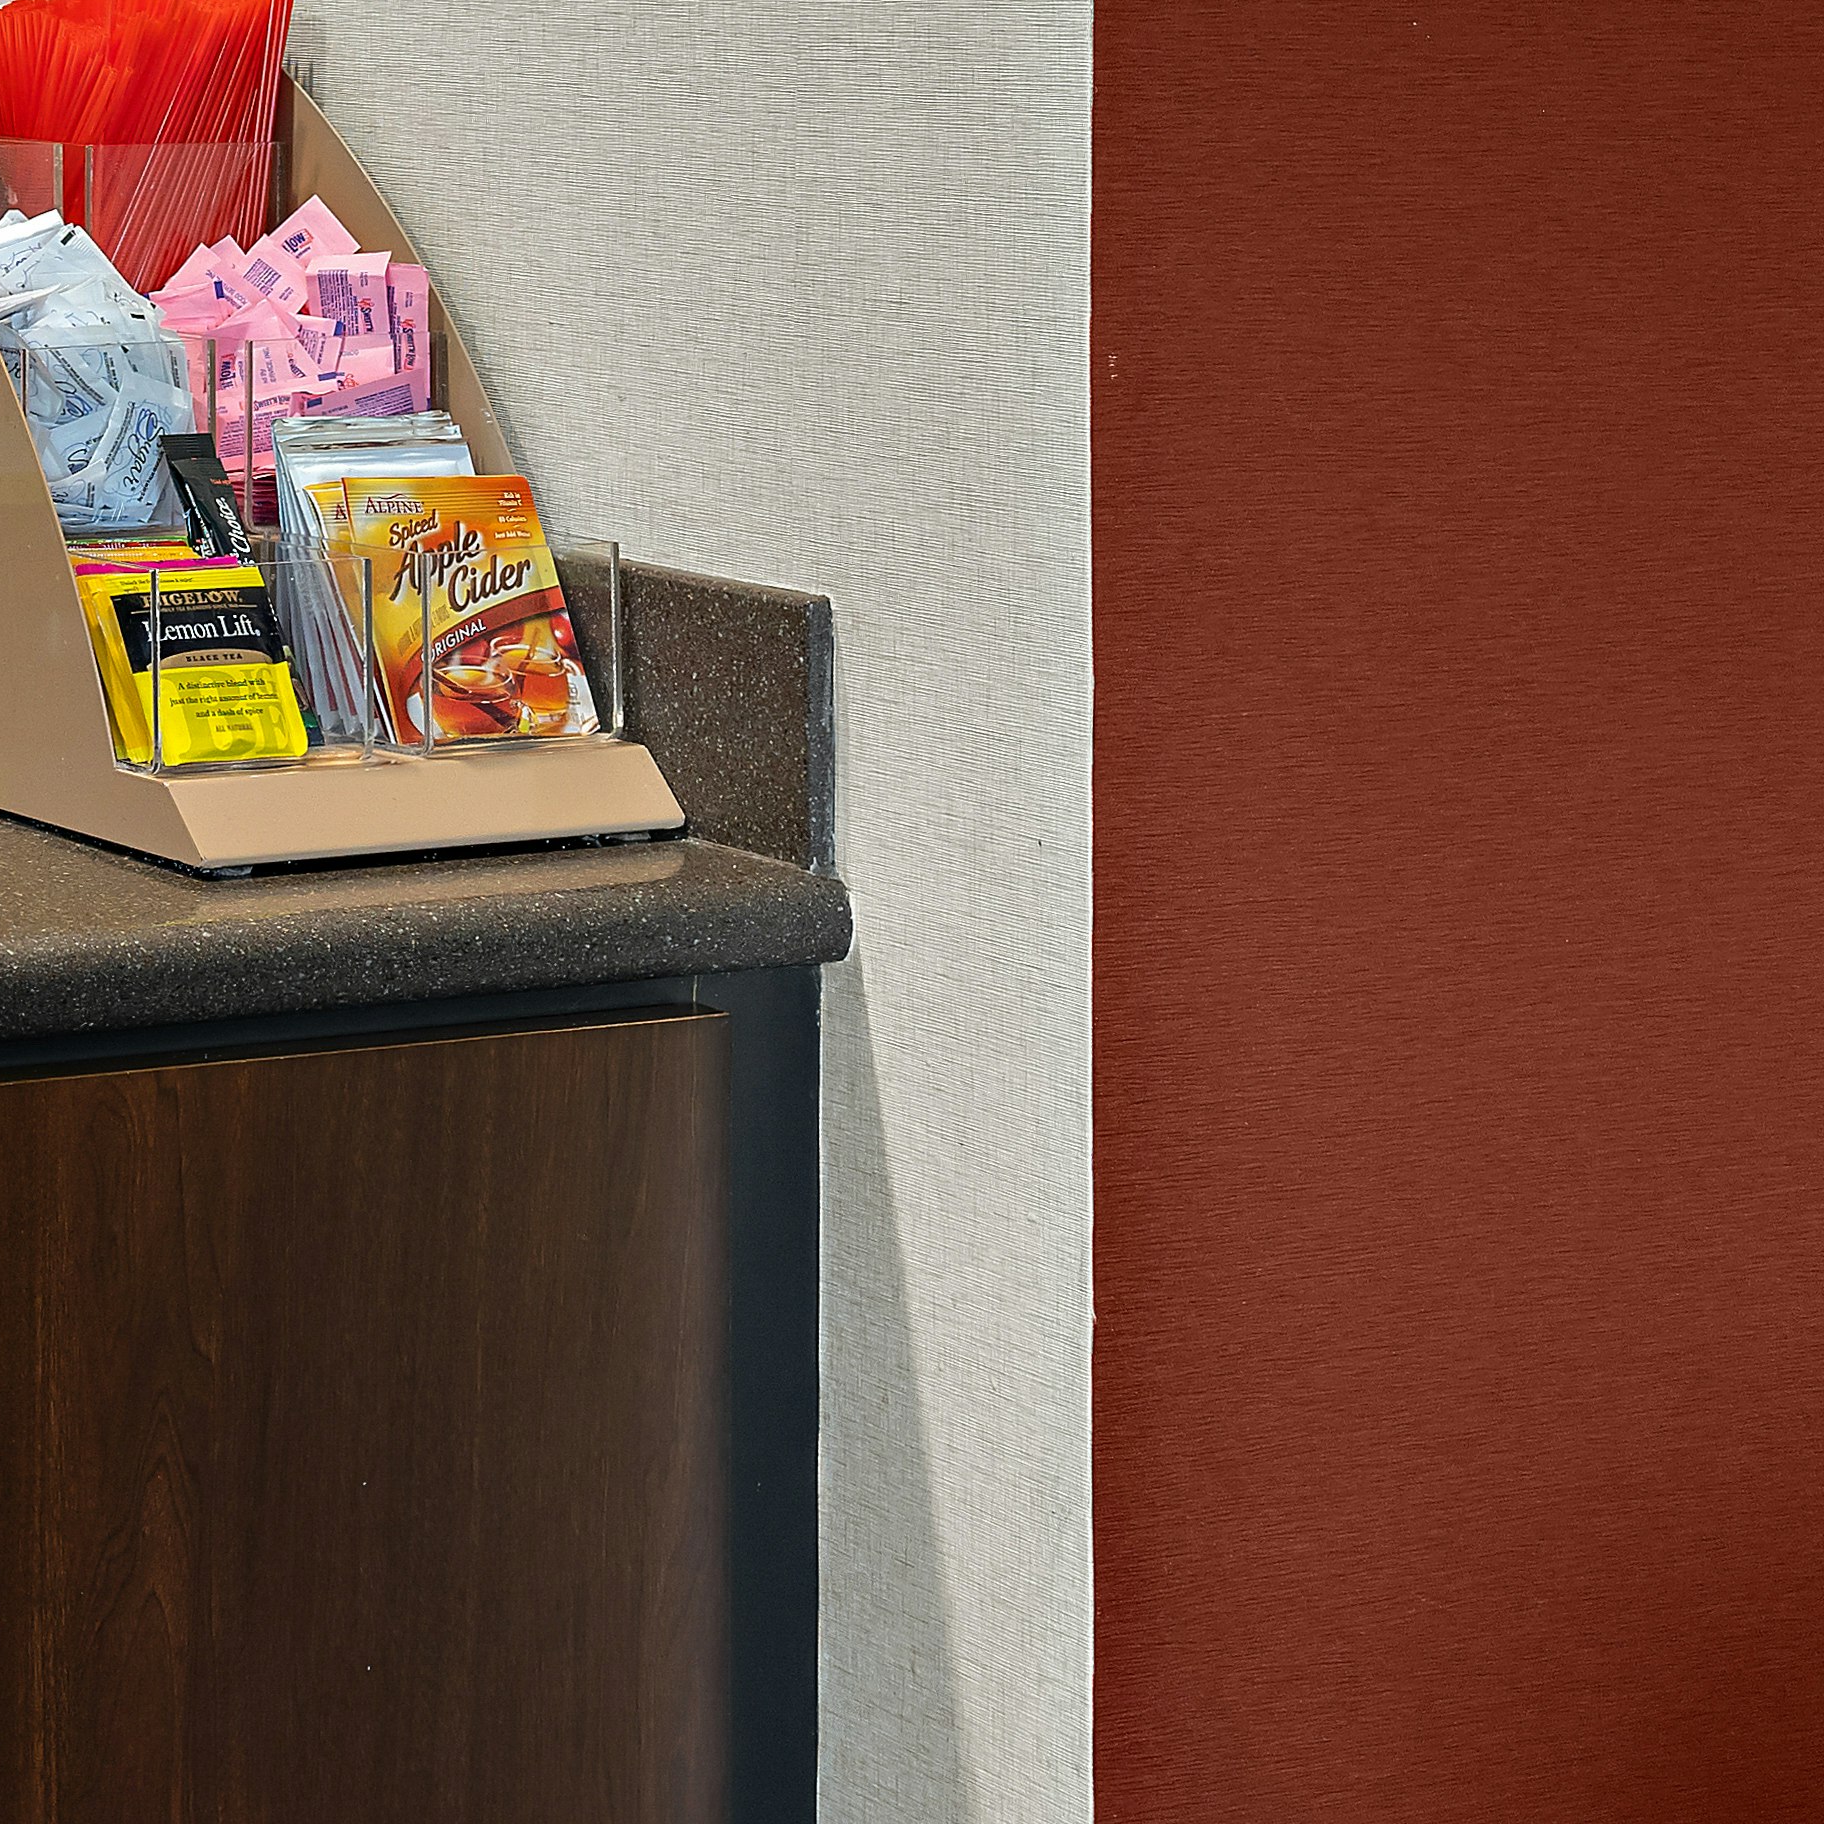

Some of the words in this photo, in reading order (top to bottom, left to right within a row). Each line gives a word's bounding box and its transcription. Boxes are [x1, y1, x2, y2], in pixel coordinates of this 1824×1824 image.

[365, 496, 423, 514] ALPINE
[215, 497, 251, 553] Choice
[389, 509, 439, 547] Spiced
[389, 520, 481, 601] Apple
[447, 554, 532, 613] Cider
[186, 654, 219, 662] BLACK
[178, 682, 185, 690] A
[248, 678, 265, 686] with
[186, 696, 198, 704] the
[199, 695, 218, 705] right
[196, 709, 210, 717] and
[236, 707, 244, 715] of
[245, 707, 263, 716] spice
